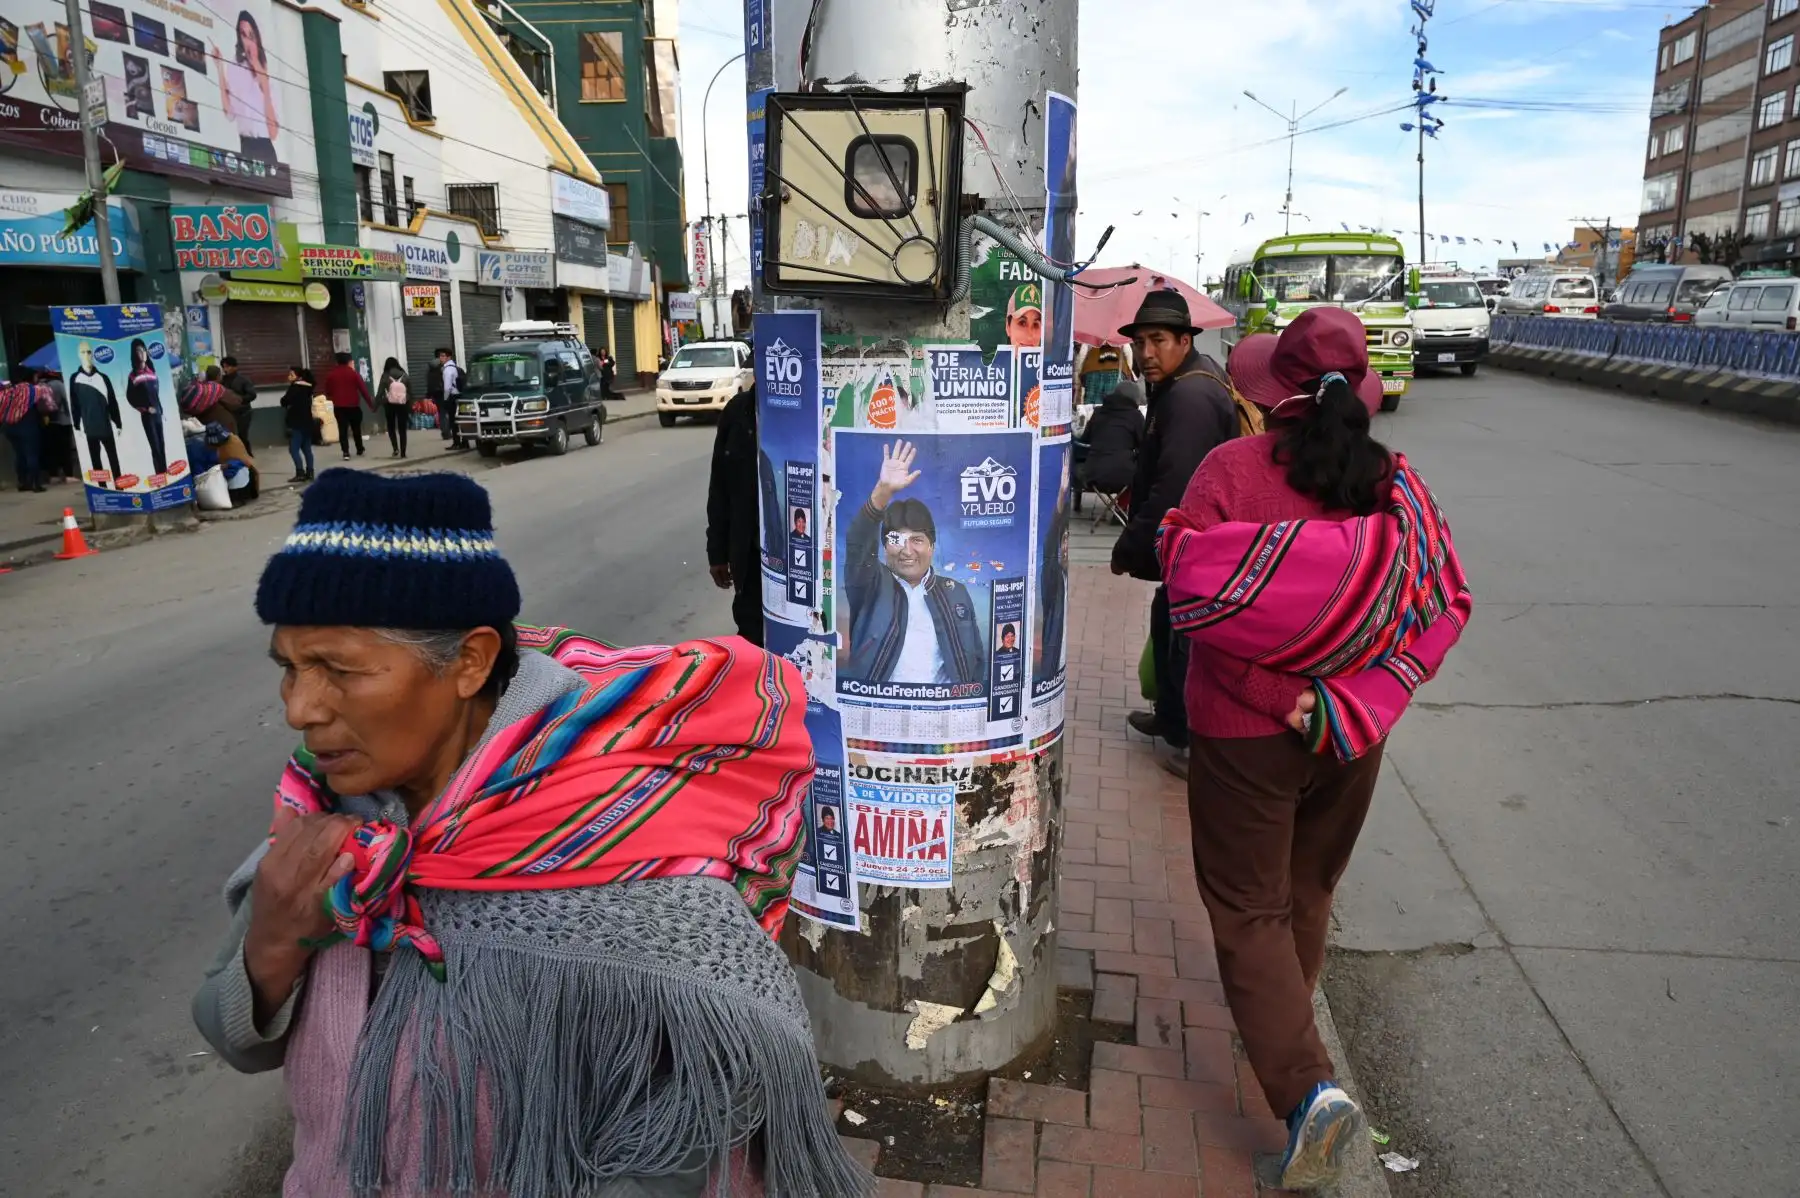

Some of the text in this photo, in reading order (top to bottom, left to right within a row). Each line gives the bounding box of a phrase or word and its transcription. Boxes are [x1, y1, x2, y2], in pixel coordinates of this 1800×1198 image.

[146, 115, 178, 135] Cocoas
[172, 206, 269, 241] BAÑO
[176, 243, 274, 269] PÚBLICO
[303, 258, 354, 268] SERVICIO
[396, 243, 448, 265] NOTARIA
[505, 254, 548, 264] PUNTO
[404, 286, 440, 297] NOTARIA
[765, 356, 803, 383] EVO
[937, 352, 960, 367] DE
[987, 366, 1005, 380] EN
[960, 475, 1017, 502] EVO
[862, 789, 876, 799] DE
[879, 791, 951, 805] VIDRIO
[854, 812, 947, 860] AMINA
